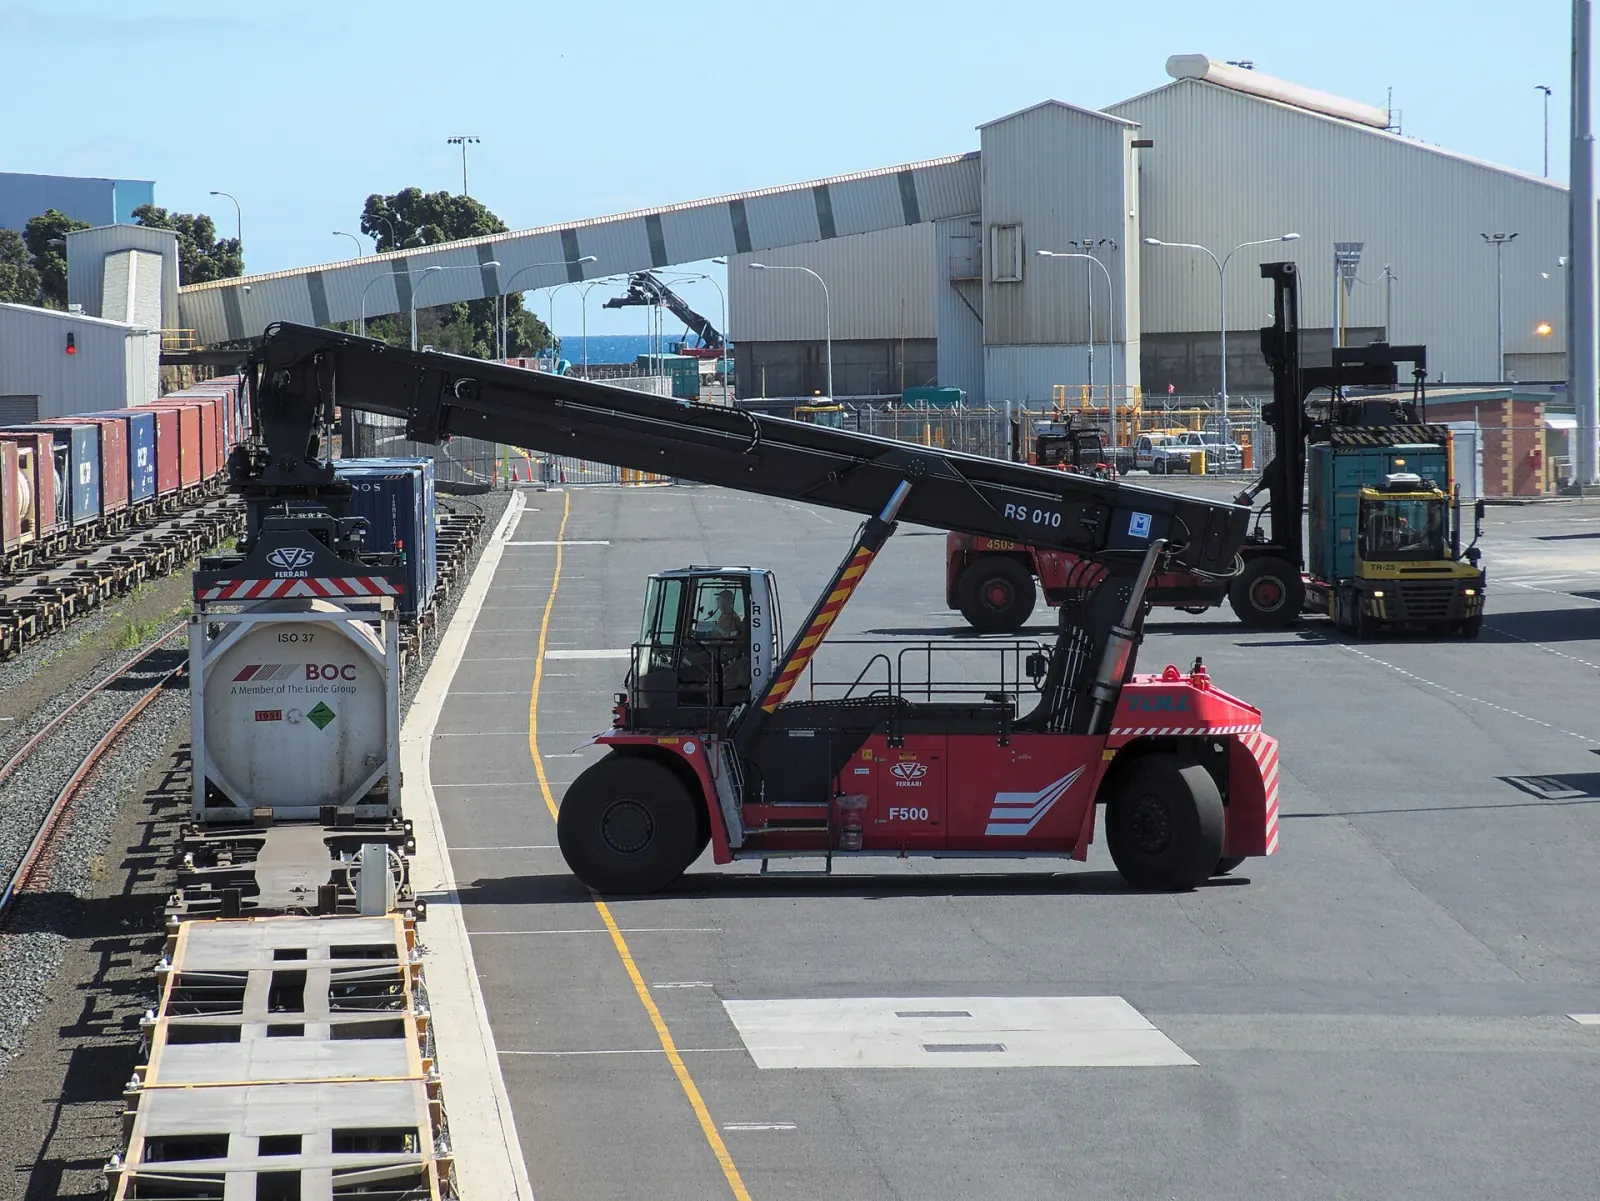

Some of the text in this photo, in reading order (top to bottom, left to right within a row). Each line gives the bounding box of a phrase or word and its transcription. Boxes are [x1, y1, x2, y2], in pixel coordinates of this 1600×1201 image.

[1004, 503, 1061, 527] RS 010
[266, 547, 315, 570] CVS
[275, 570, 308, 578] FERRARI
[752, 605, 761, 628] RS
[278, 633, 315, 643] ISO 37
[305, 663, 356, 681] BOC
[230, 684, 357, 695] A Member of The Linde Group
[257, 711, 280, 720] 1951
[889, 762, 928, 780] CVS
[889, 807, 929, 821] F500
